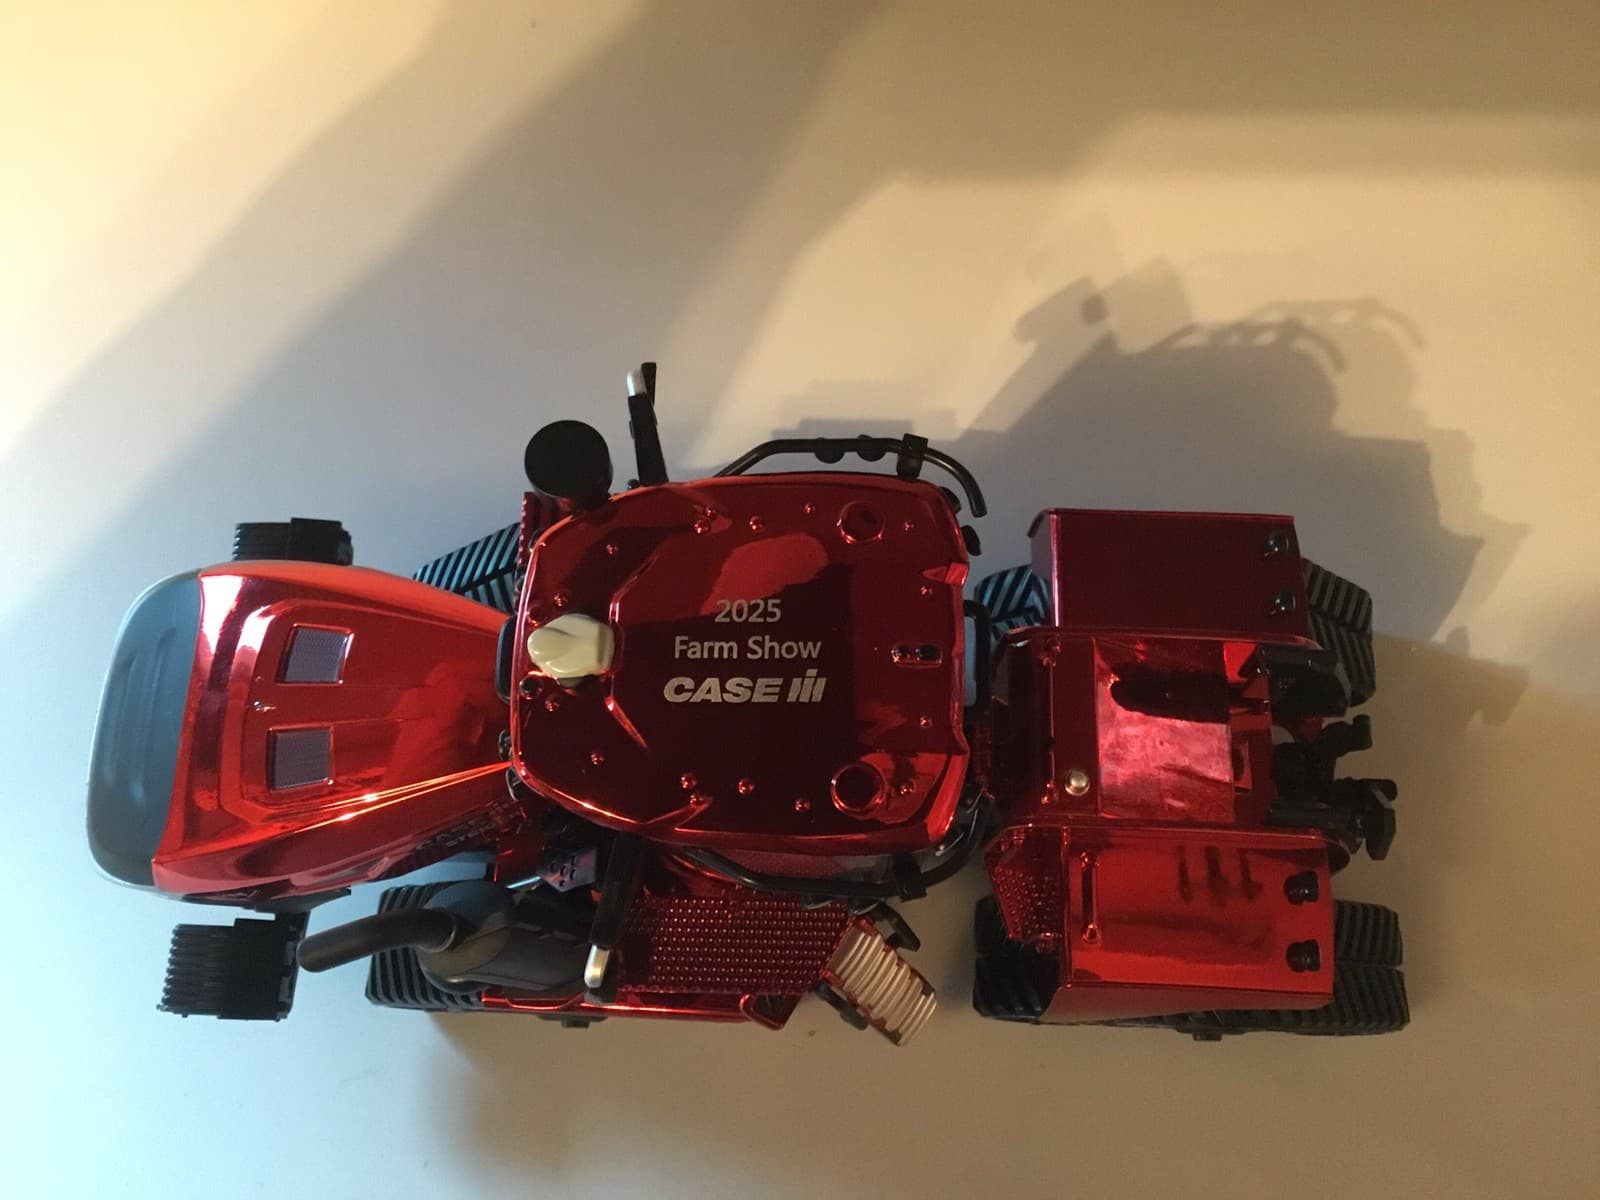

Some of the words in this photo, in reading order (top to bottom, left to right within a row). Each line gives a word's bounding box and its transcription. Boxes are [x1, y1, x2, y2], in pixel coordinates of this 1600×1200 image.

[714, 599, 782, 623] 2025
[674, 635, 739, 659] Farm
[747, 635, 822, 660] Show
[663, 677, 784, 703] CASE
